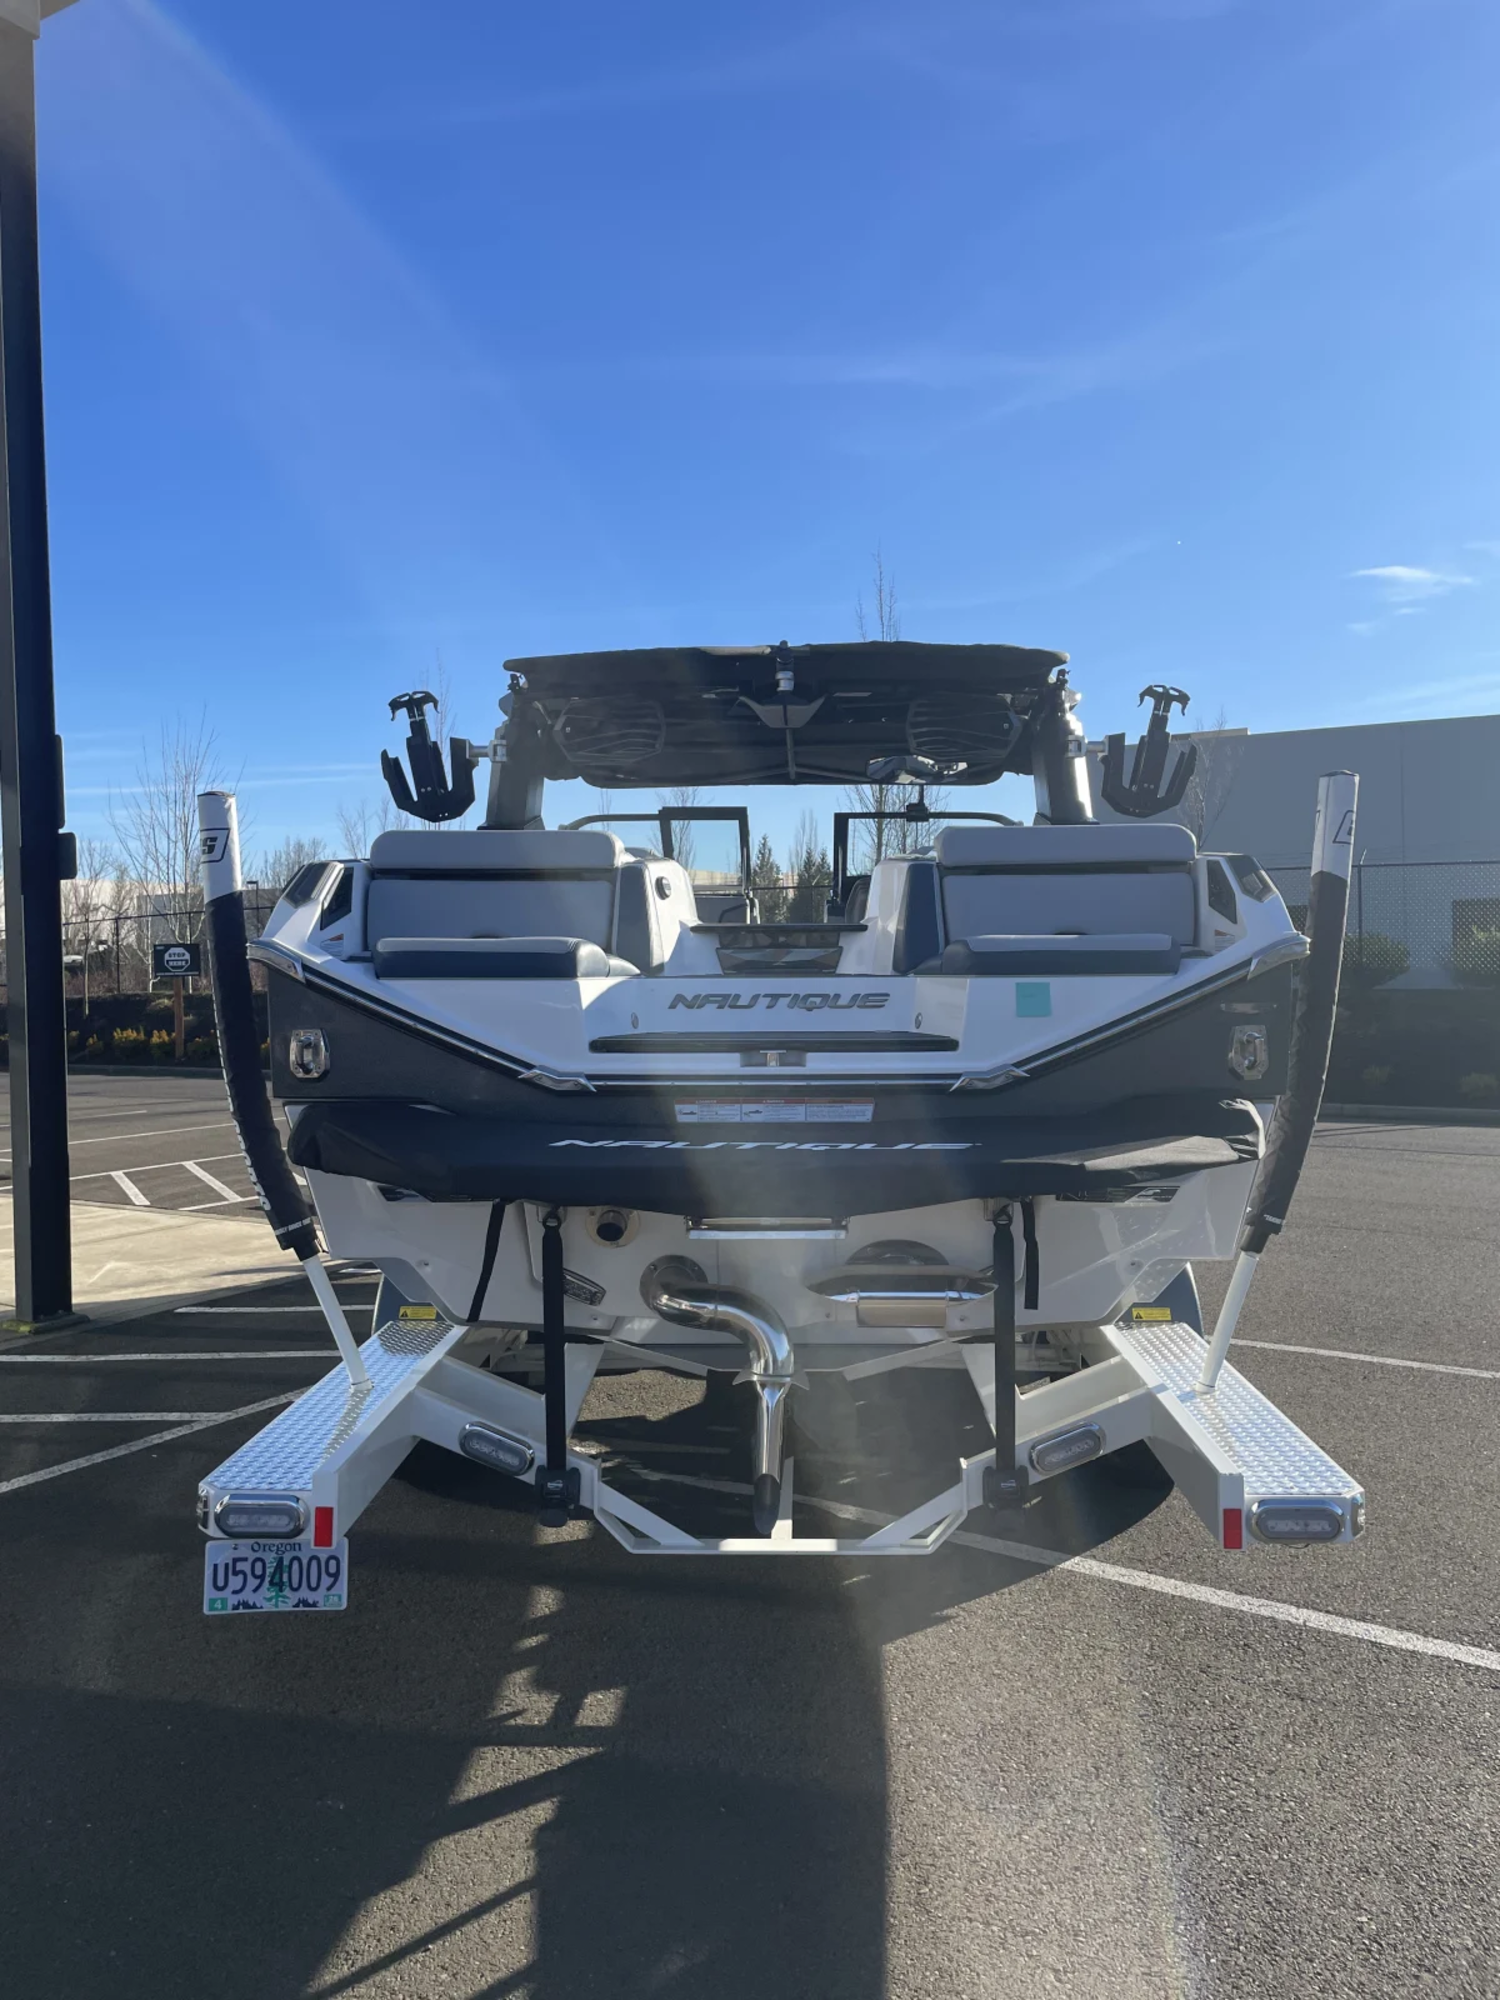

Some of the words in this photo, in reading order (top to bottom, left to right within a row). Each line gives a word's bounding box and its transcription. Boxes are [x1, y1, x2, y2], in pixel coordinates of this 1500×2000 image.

[667, 992, 891, 1012] NAUTIQUE
[549, 1139, 975, 1150] NAUTIQUE
[250, 1541, 303, 1556] Oregon
[212, 1554, 341, 1595] U594009
[213, 1600, 223, 1609] 4
